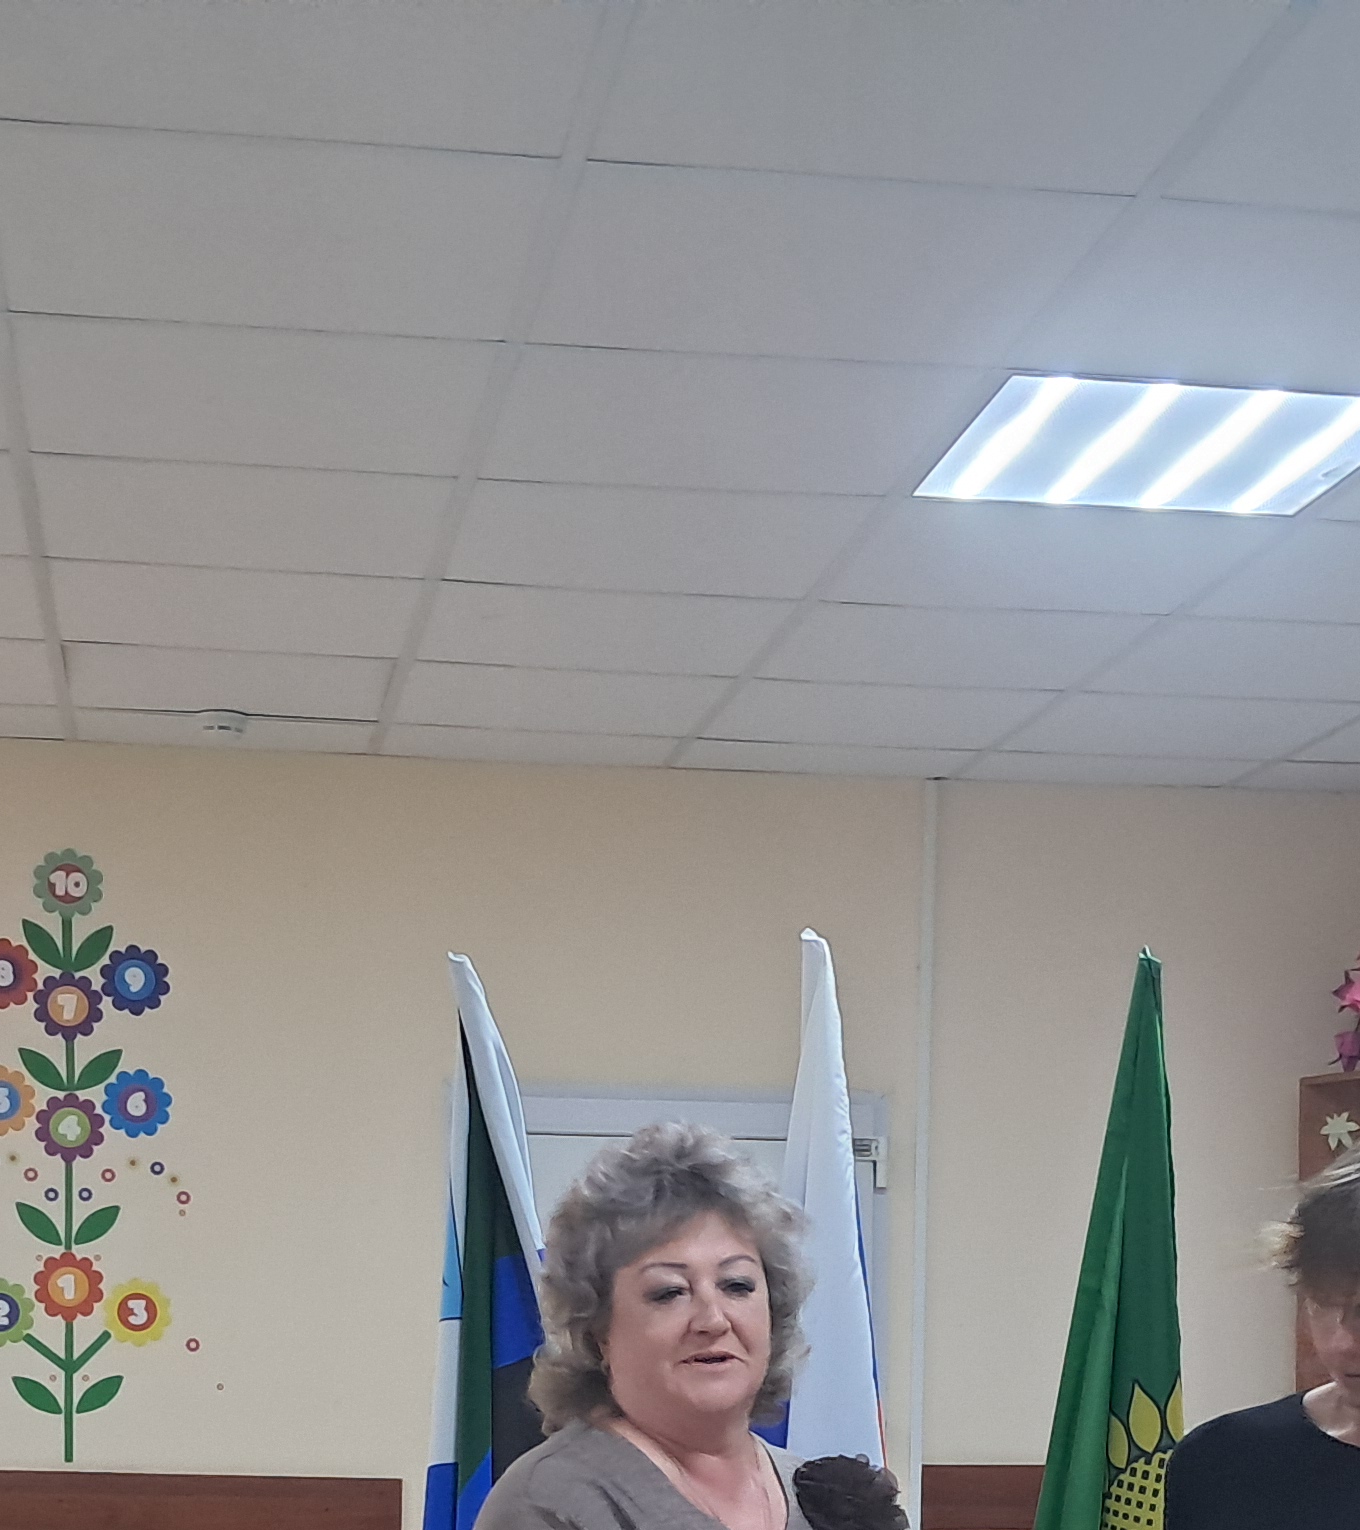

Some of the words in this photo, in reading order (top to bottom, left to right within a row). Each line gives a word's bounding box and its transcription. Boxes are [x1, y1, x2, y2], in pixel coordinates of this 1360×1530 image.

[48, 870, 89, 898] 10
[124, 967, 146, 993] 9
[57, 993, 78, 1020] 7
[126, 1091, 148, 1117] 6
[57, 1115, 82, 1141] 4
[56, 1273, 76, 1300] 1
[127, 1300, 149, 1326] 3
